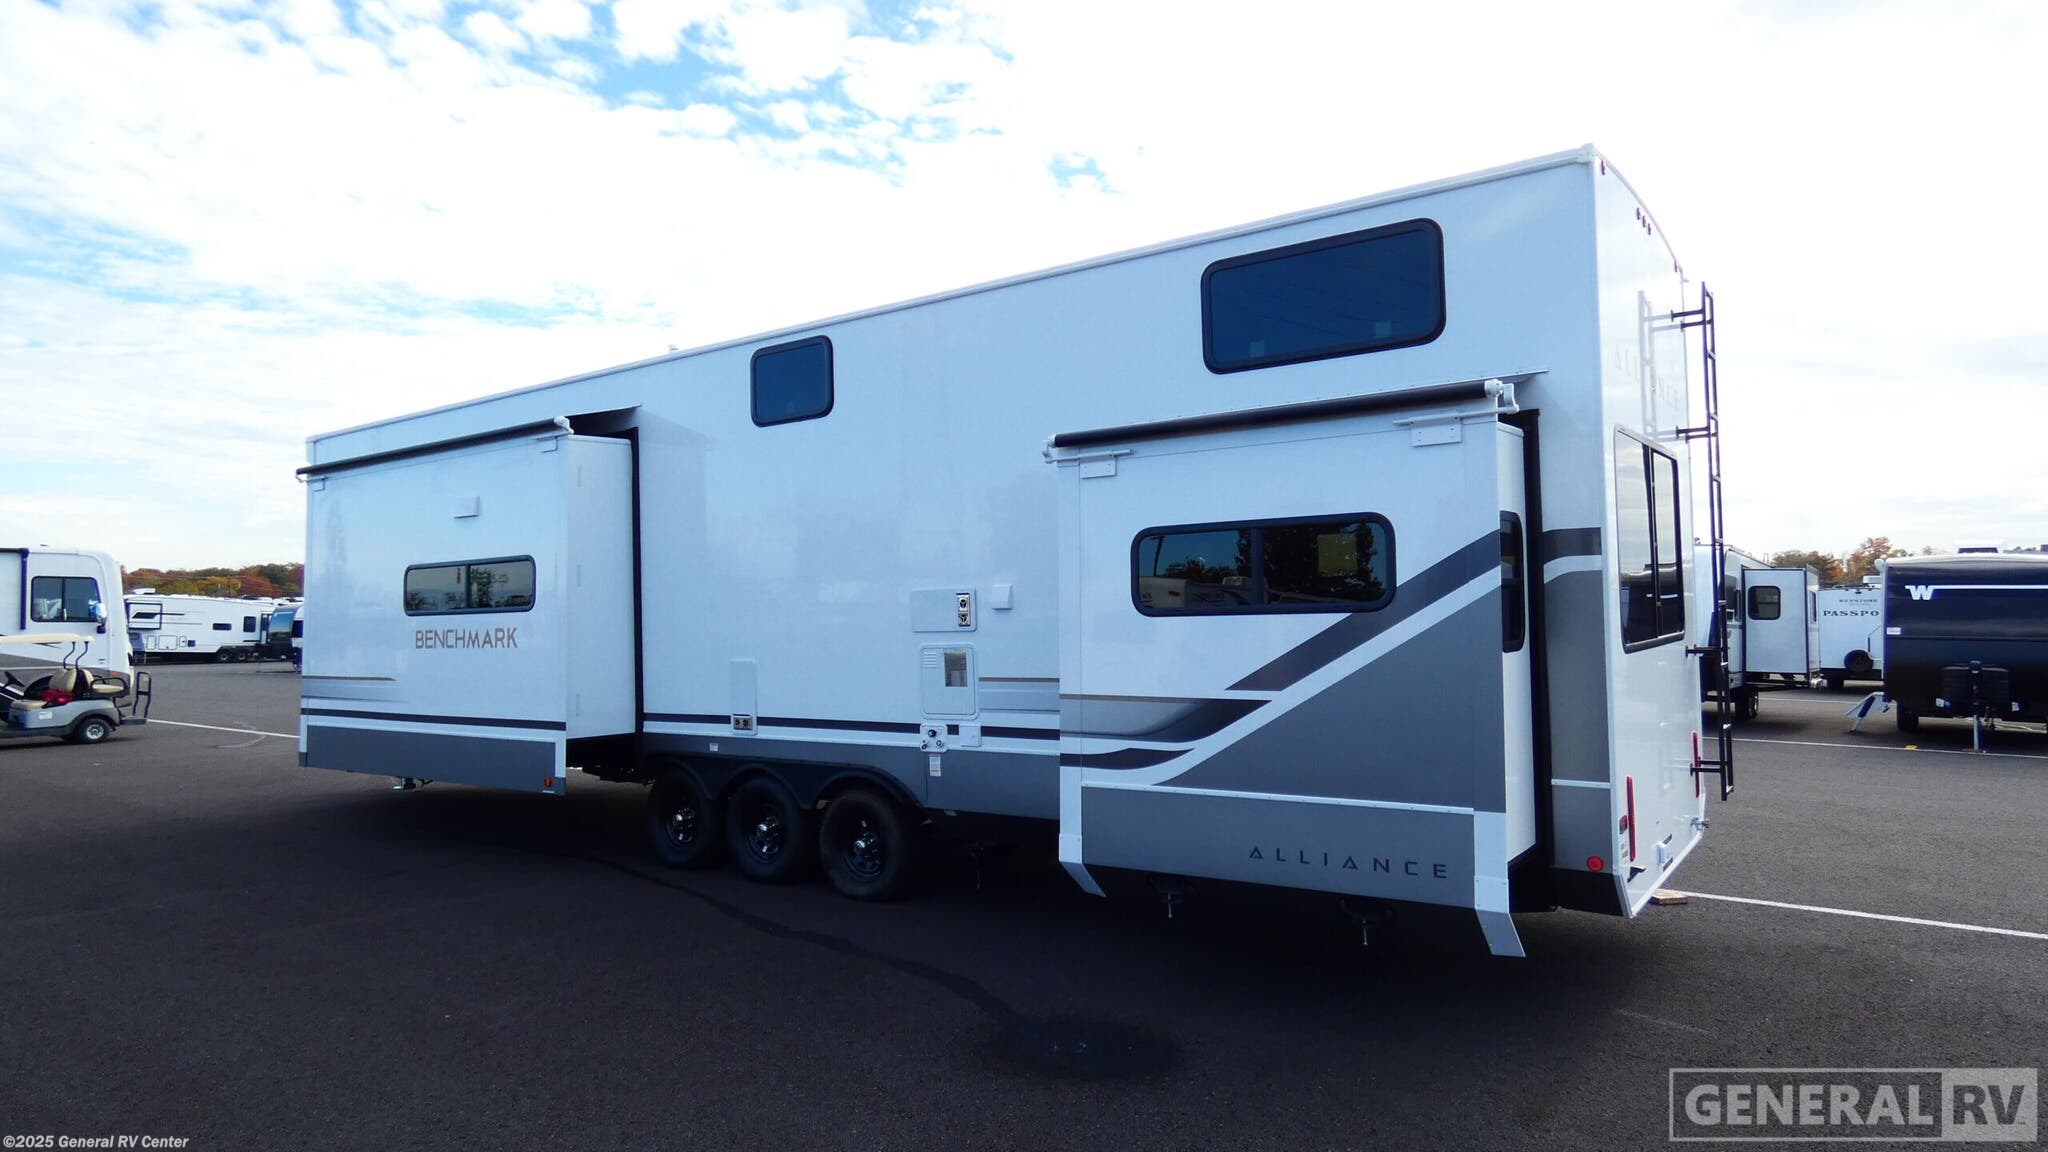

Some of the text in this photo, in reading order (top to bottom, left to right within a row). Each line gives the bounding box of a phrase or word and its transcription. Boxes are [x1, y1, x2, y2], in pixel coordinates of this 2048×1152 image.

[1614, 347, 1680, 412] ALLNCE
[415, 627, 518, 649] BENCHMARK
[1249, 846, 1447, 879] ALLIANCE
